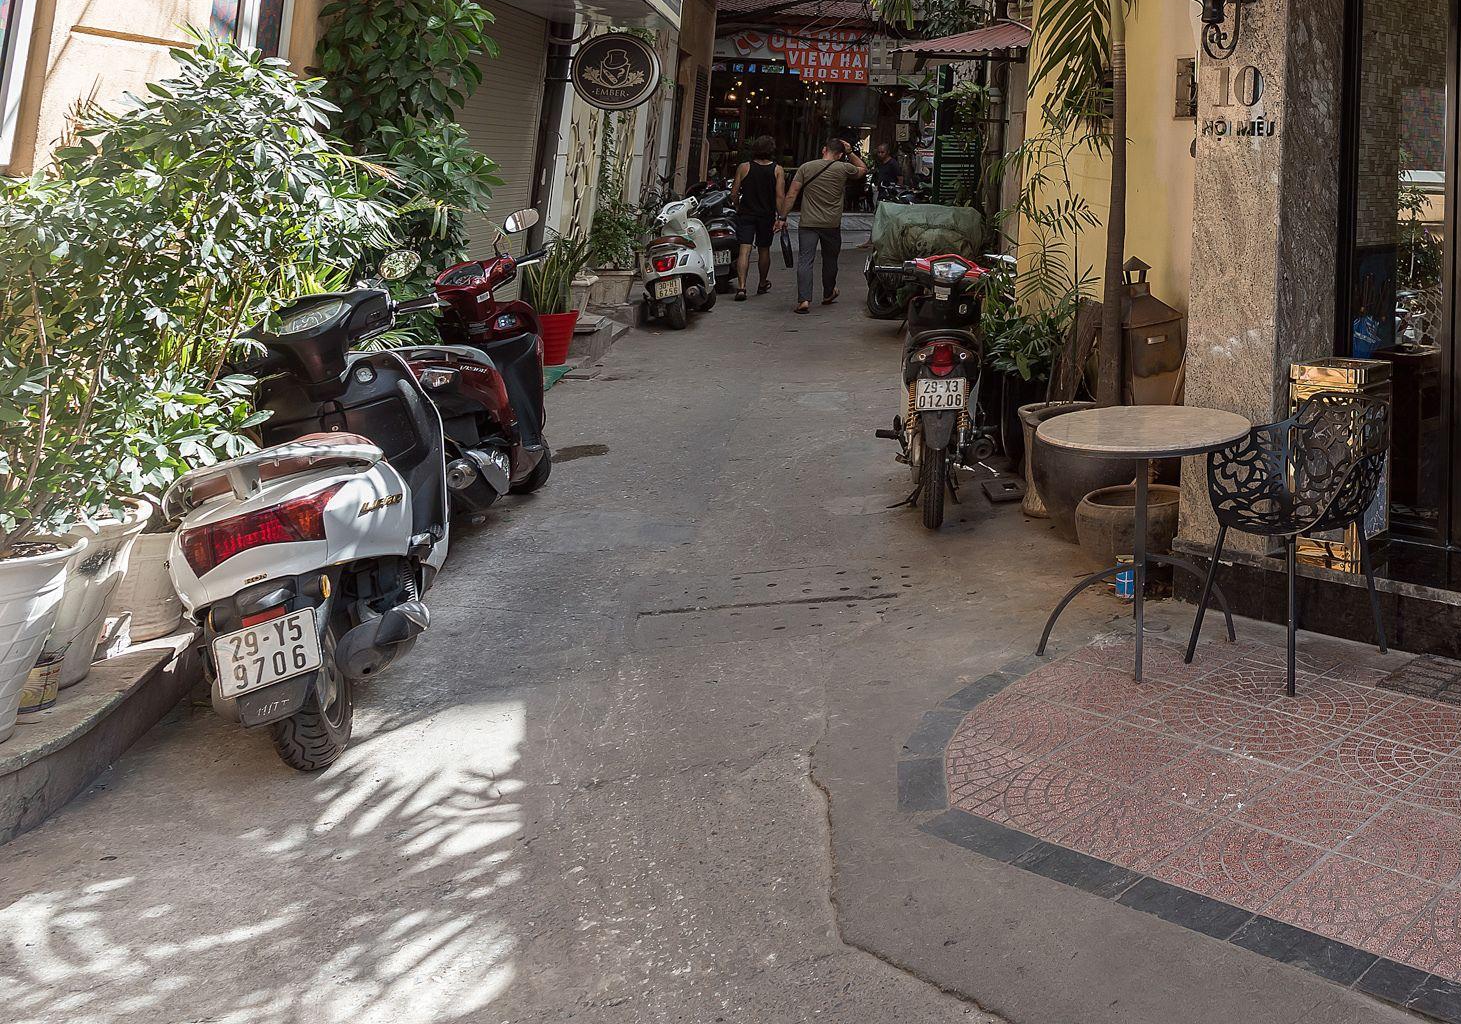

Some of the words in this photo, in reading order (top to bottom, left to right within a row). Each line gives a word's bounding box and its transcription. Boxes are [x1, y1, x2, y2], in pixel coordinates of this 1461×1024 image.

[787, 50, 835, 67] VIEW
[595, 88, 626, 97] EMBER
[1212, 65, 1264, 107] 10
[923, 380, 959, 394] 29-X3
[918, 394, 962, 408] 012.06
[229, 616, 302, 663] 29-Y5
[233, 645, 306, 689] 9706
